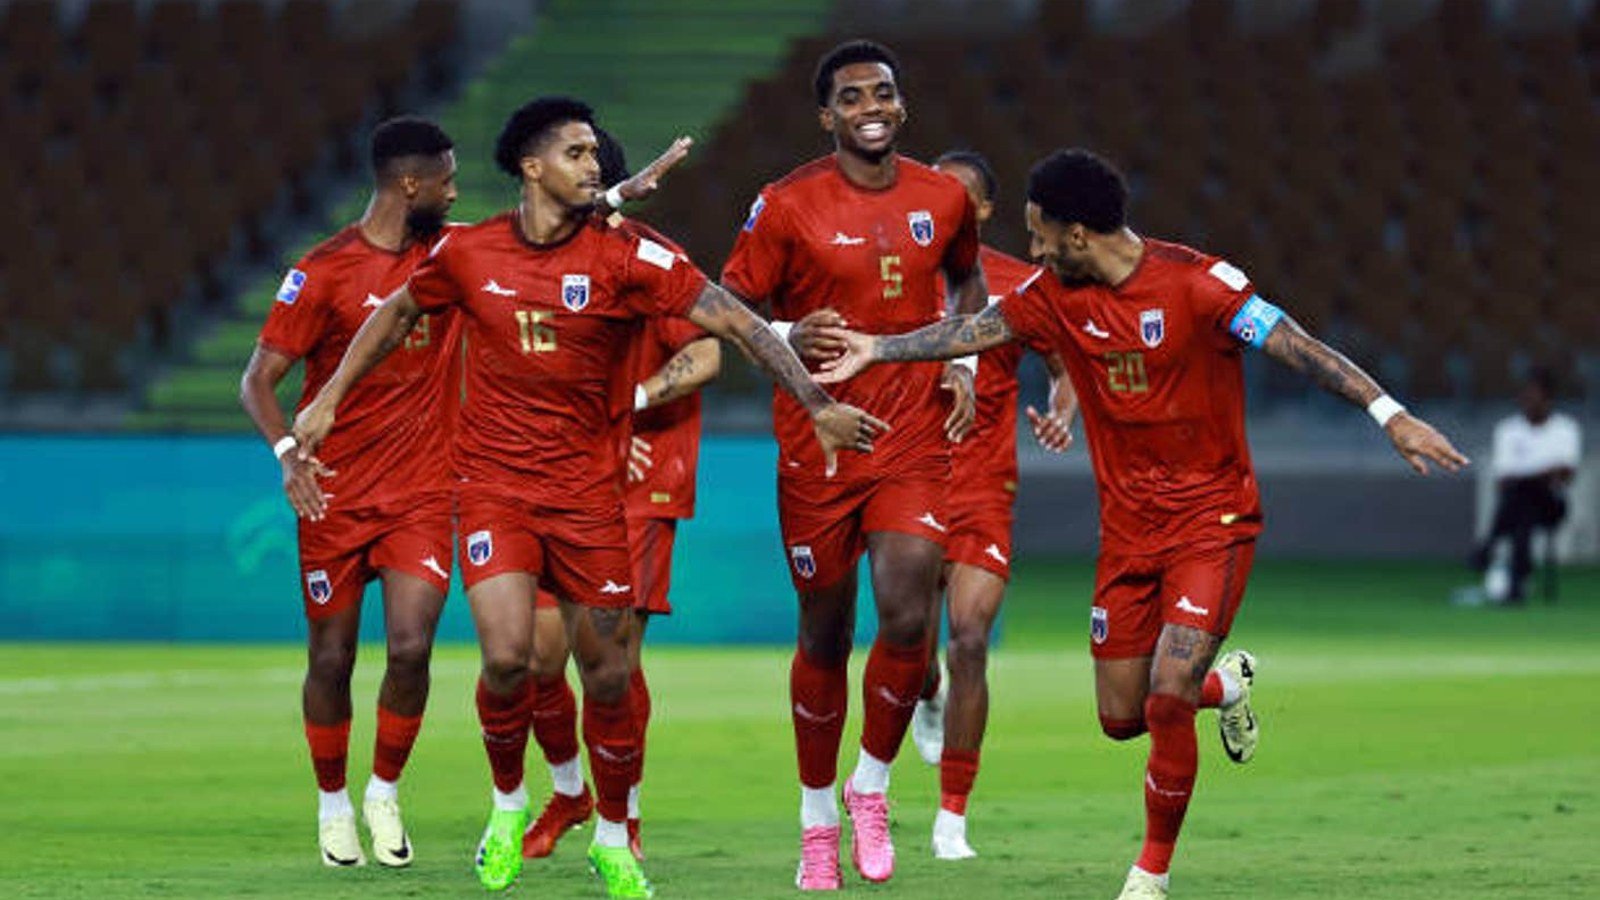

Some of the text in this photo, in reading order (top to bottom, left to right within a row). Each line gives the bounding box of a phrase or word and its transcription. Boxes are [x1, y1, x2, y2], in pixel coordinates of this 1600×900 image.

[880, 256, 902, 300] 5
[515, 310, 556, 354] 16
[1104, 351, 1148, 392] 20
